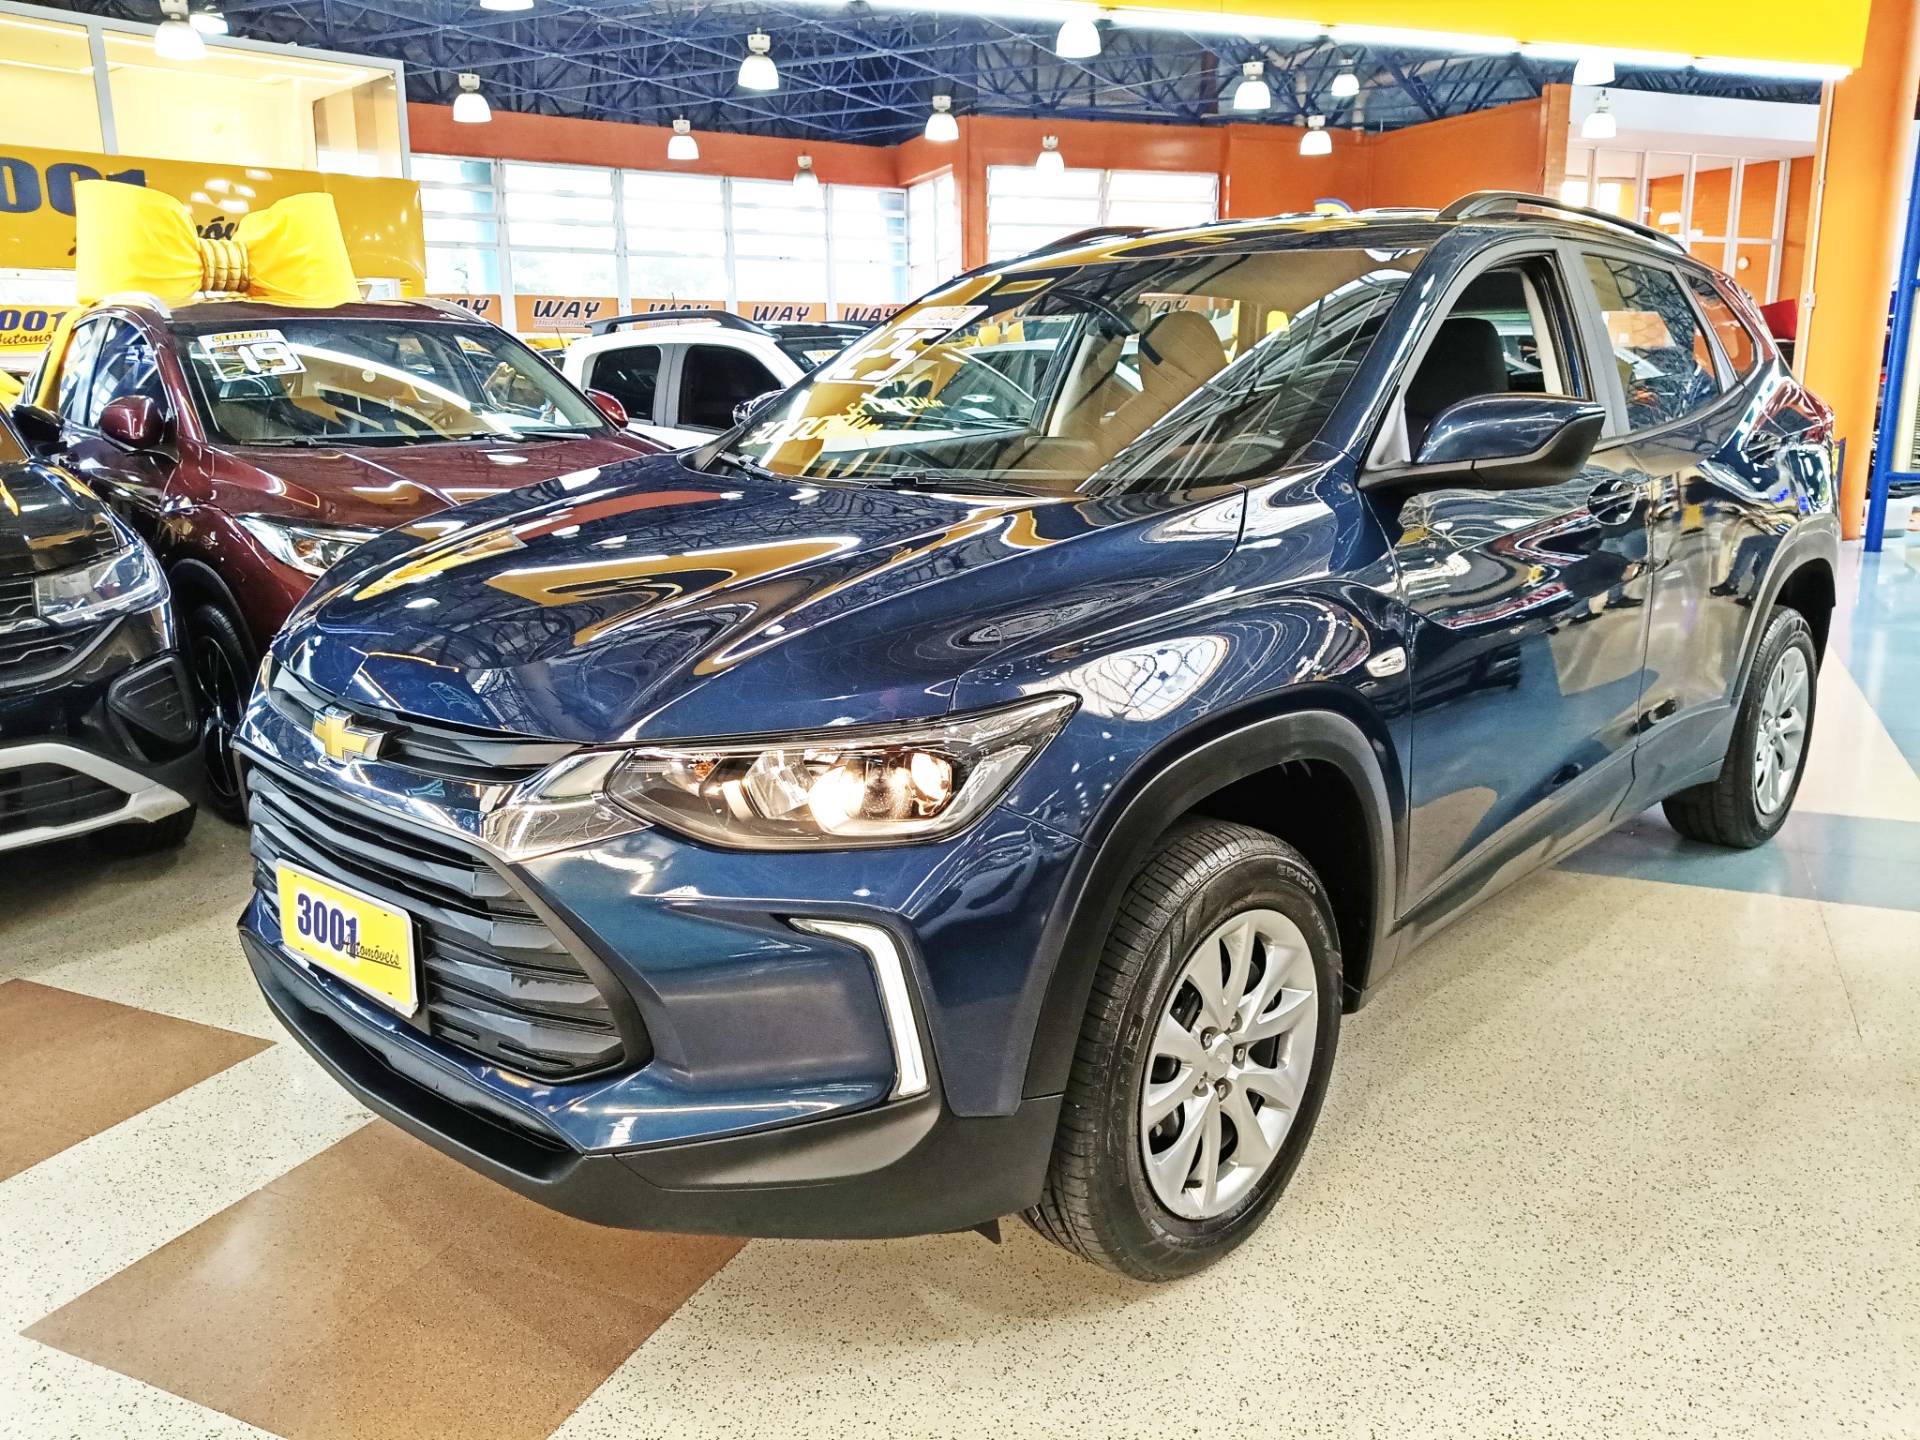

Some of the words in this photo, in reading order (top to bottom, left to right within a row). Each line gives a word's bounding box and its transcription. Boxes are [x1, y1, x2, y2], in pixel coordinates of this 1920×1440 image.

[534, 300, 600, 319] WAY
[753, 306, 809, 321] WAY
[237, 342, 302, 375] 19
[297, 893, 357, 952] 3001
